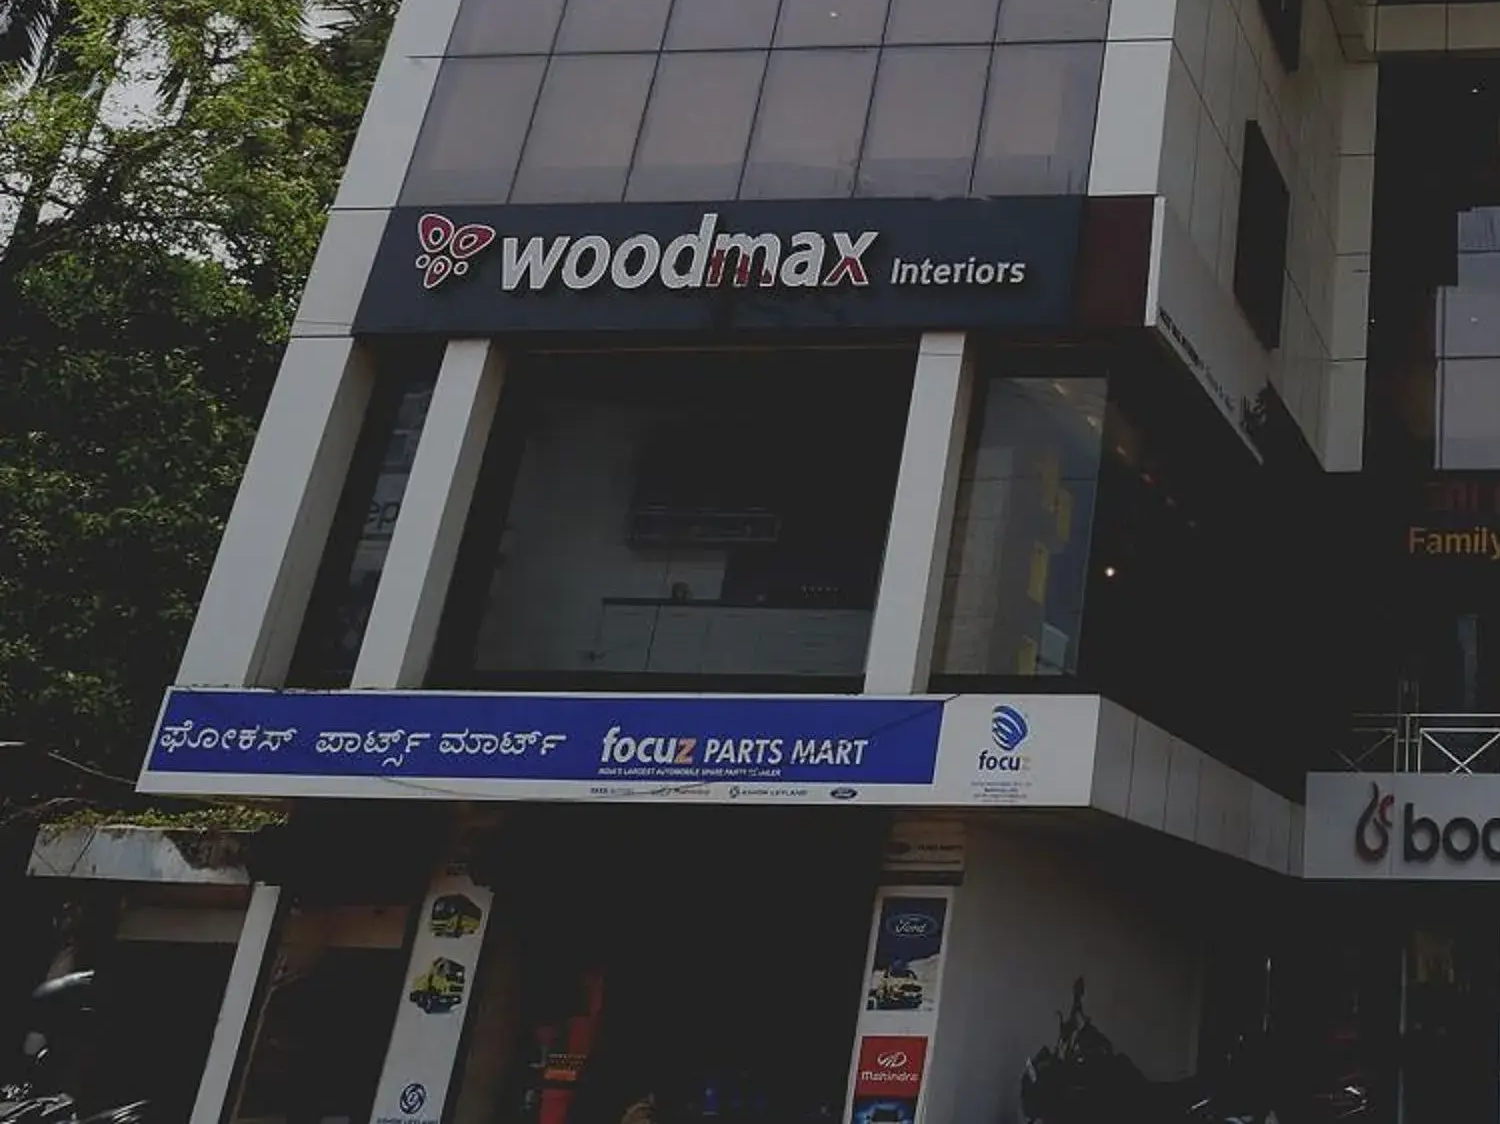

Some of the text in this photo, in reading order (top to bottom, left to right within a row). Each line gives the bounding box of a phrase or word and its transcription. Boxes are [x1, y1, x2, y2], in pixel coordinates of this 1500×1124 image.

[502, 212, 1027, 291] woodmax Interiors
[601, 725, 869, 766] focuz PARTS MART
